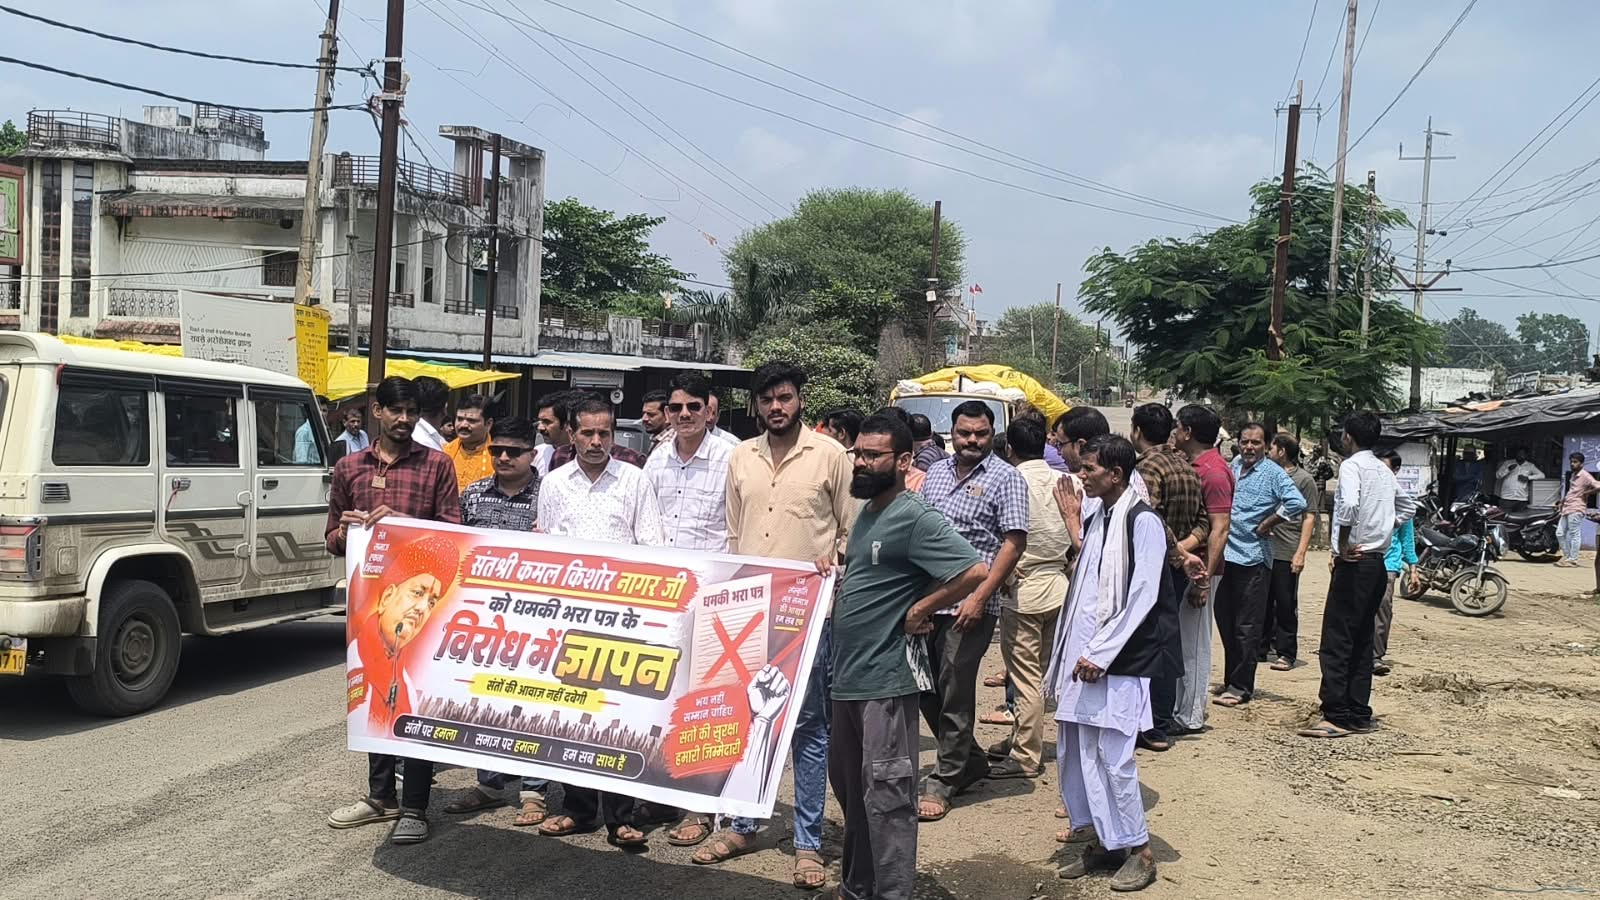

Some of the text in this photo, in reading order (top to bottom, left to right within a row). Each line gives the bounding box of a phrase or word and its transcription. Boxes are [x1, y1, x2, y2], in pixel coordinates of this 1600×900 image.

[470, 550, 688, 600] संतश्री कमल किशोर नागर जी
[703, 586, 764, 607] धमकी भरा पत्र
[488, 592, 640, 629] को धमकी भरा पत्र के
[780, 603, 788, 613] की
[775, 614, 804, 626] हम सब एक
[0, 653, 23, 669] 710
[433, 609, 682, 692] विरोध में ज्ञापन
[486, 678, 588, 705] संतों की आवाज़ नहीं दबेगी
[695, 690, 725, 707] भय नहीं
[683, 704, 733, 723] सम्मान चाहिए
[404, 719, 458, 741] संतों पर हमला
[698, 722, 711, 740] की
[712, 722, 739, 742] सुरक्षा
[474, 733, 540, 755] समाज पर हमला
[675, 738, 742, 766] हमारी जिम्मेदारी
[562, 748, 628, 771] हम सब साथ हैं
